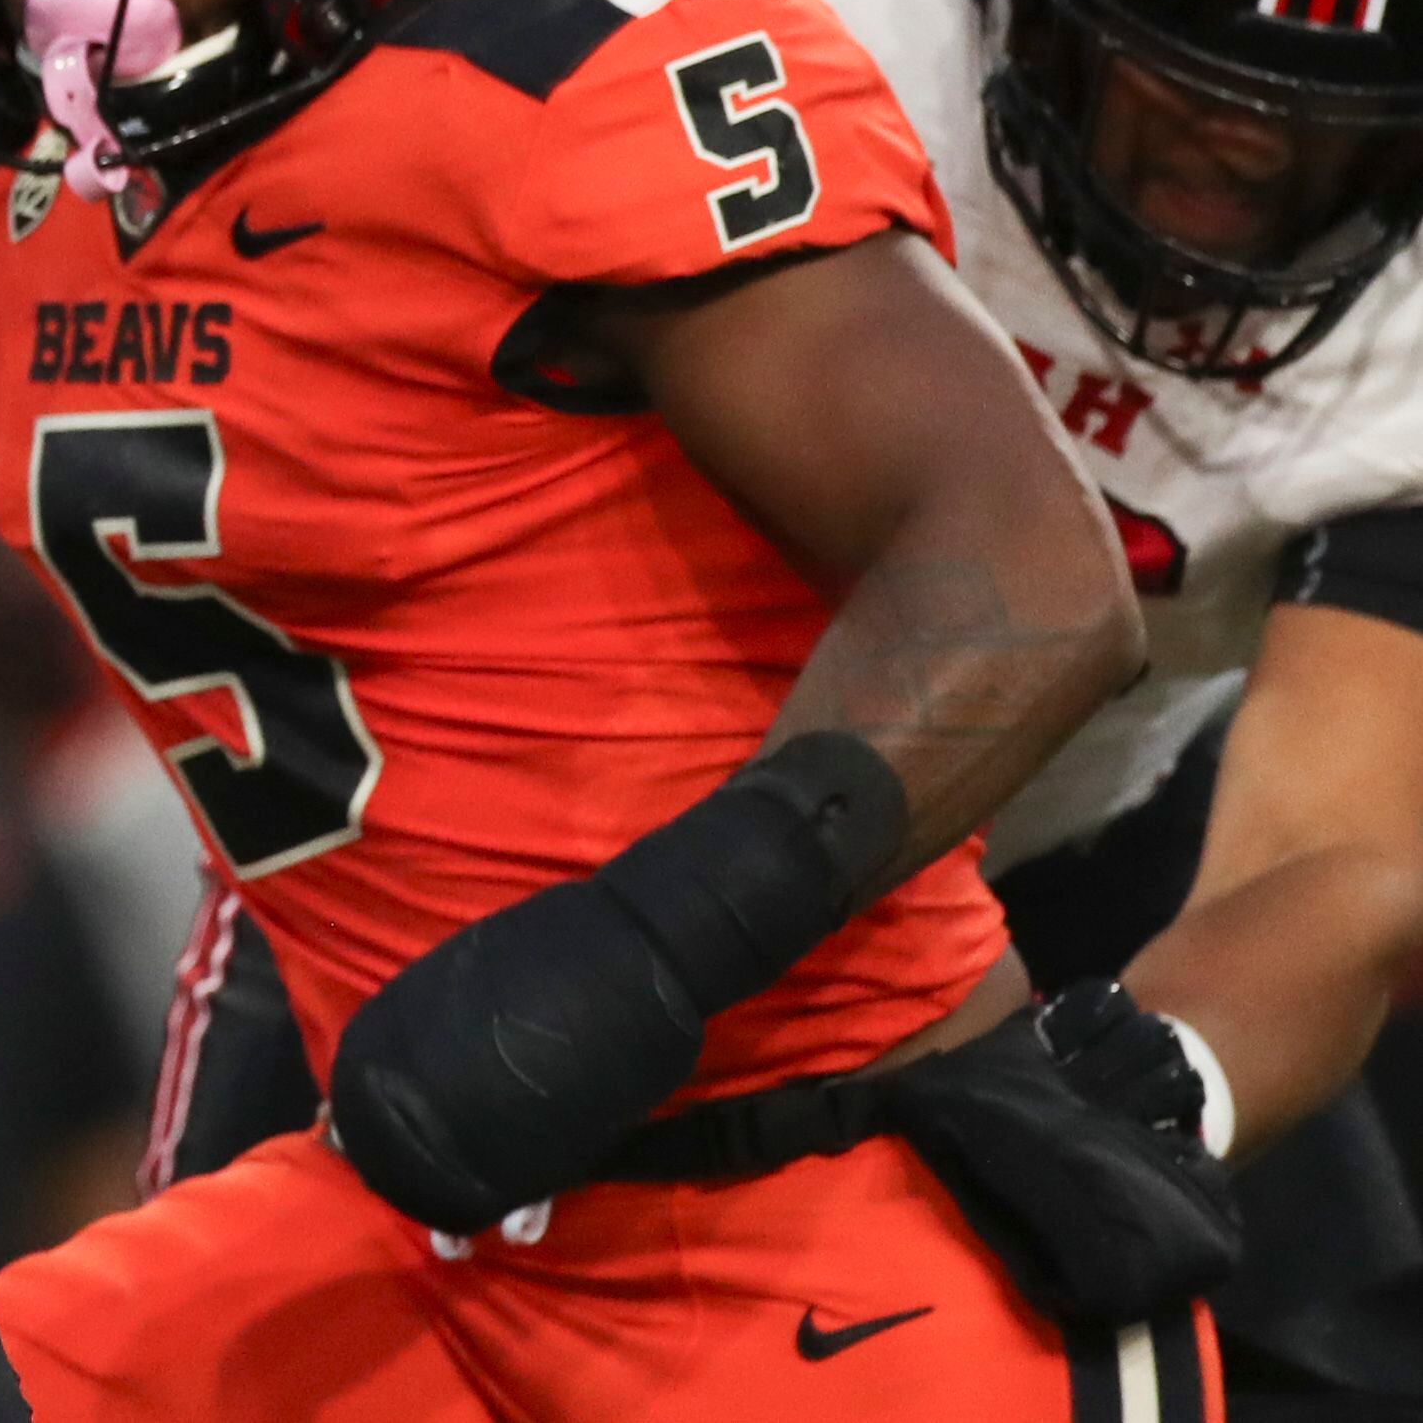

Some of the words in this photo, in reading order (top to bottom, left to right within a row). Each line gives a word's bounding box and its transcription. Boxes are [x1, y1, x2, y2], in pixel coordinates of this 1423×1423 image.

[666, 31, 821, 253] 5
[29, 300, 234, 385] BEAVS
[28, 408, 383, 882] 5
